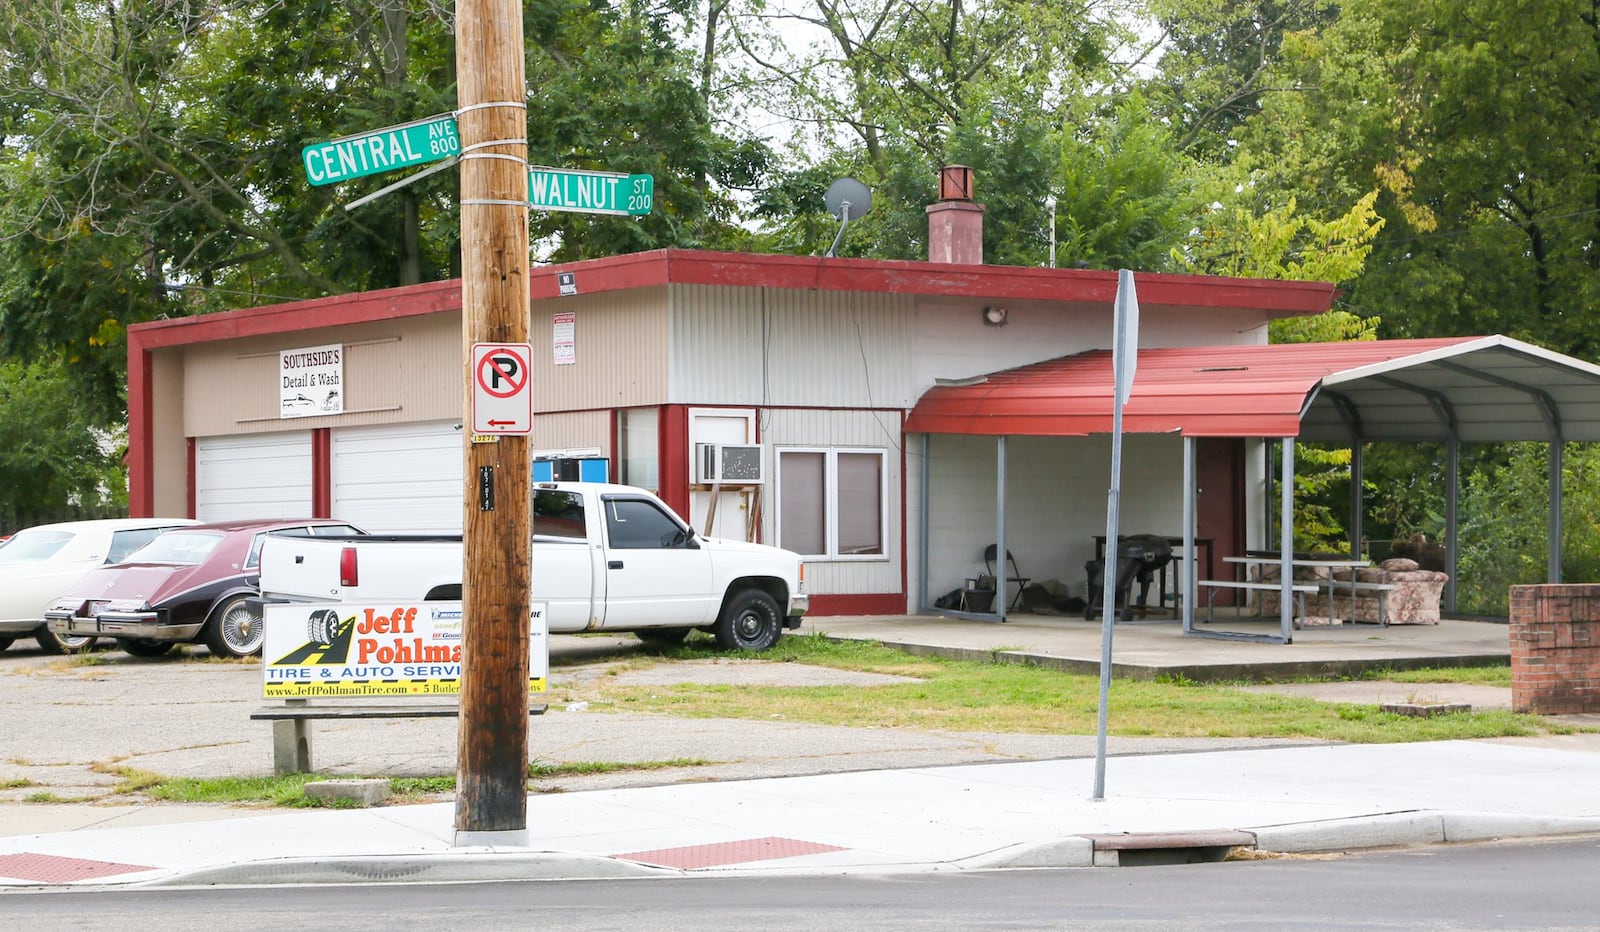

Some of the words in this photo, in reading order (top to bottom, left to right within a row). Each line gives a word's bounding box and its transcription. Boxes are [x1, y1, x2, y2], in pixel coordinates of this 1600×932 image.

[306, 130, 422, 181] CENTRAL
[429, 120, 454, 139] AVE
[430, 136, 458, 155] 800
[530, 172, 619, 209] WALNUT
[633, 179, 647, 194] ST
[628, 194, 651, 210] 200
[283, 350, 340, 369] SOUTHSIDE'S
[283, 373, 308, 388] Detail
[310, 374, 316, 386] &
[318, 370, 340, 386] Wash
[357, 607, 418, 634] Jeff
[357, 638, 462, 664] Pohlma
[266, 668, 311, 678] TIRE
[320, 668, 332, 678] &
[341, 667, 394, 677] AUTO
[403, 666, 460, 676] SERVI
[266, 685, 407, 696] www.JeffPohlmanTire.com
[424, 685, 430, 693] 5
